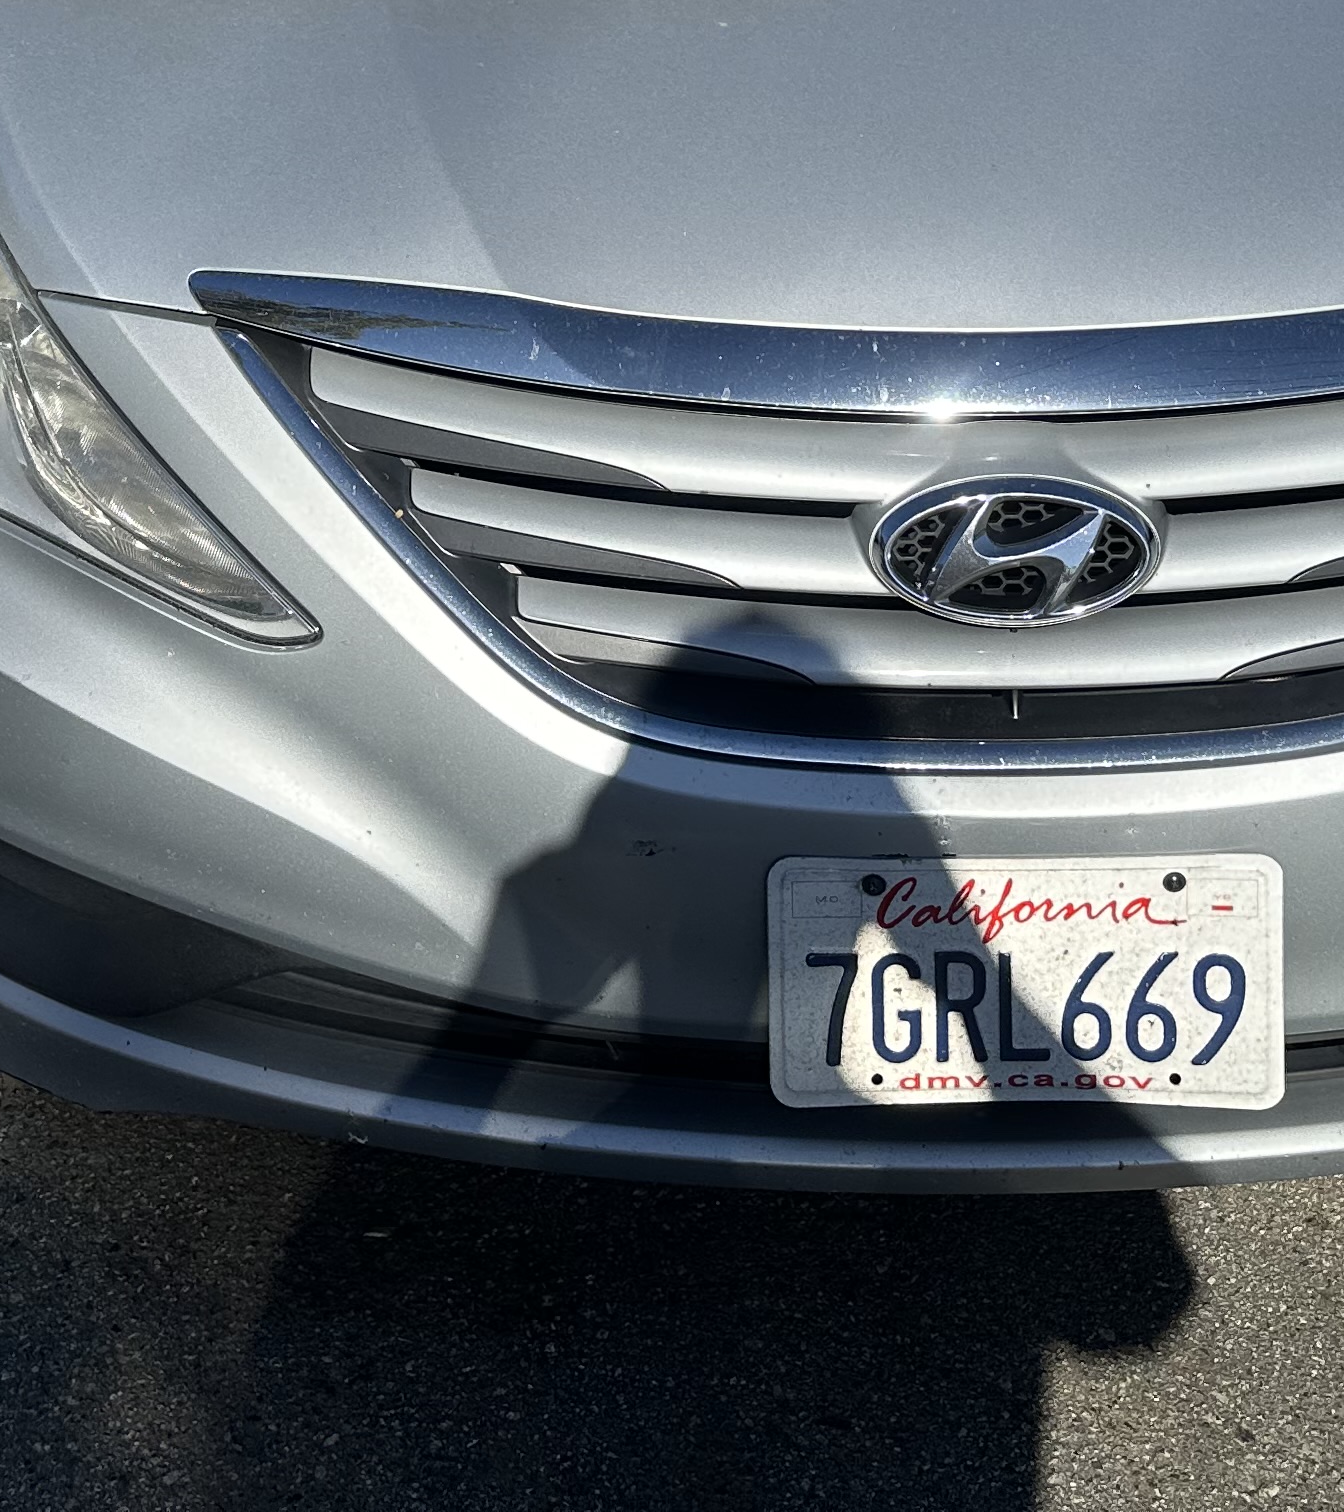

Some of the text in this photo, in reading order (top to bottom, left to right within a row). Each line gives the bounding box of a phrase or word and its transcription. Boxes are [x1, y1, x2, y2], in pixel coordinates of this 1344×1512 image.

[876, 877, 1187, 944] California
[806, 951, 1247, 1066] 7GRL669
[899, 1071, 1154, 1090] dmv.ca.gov
